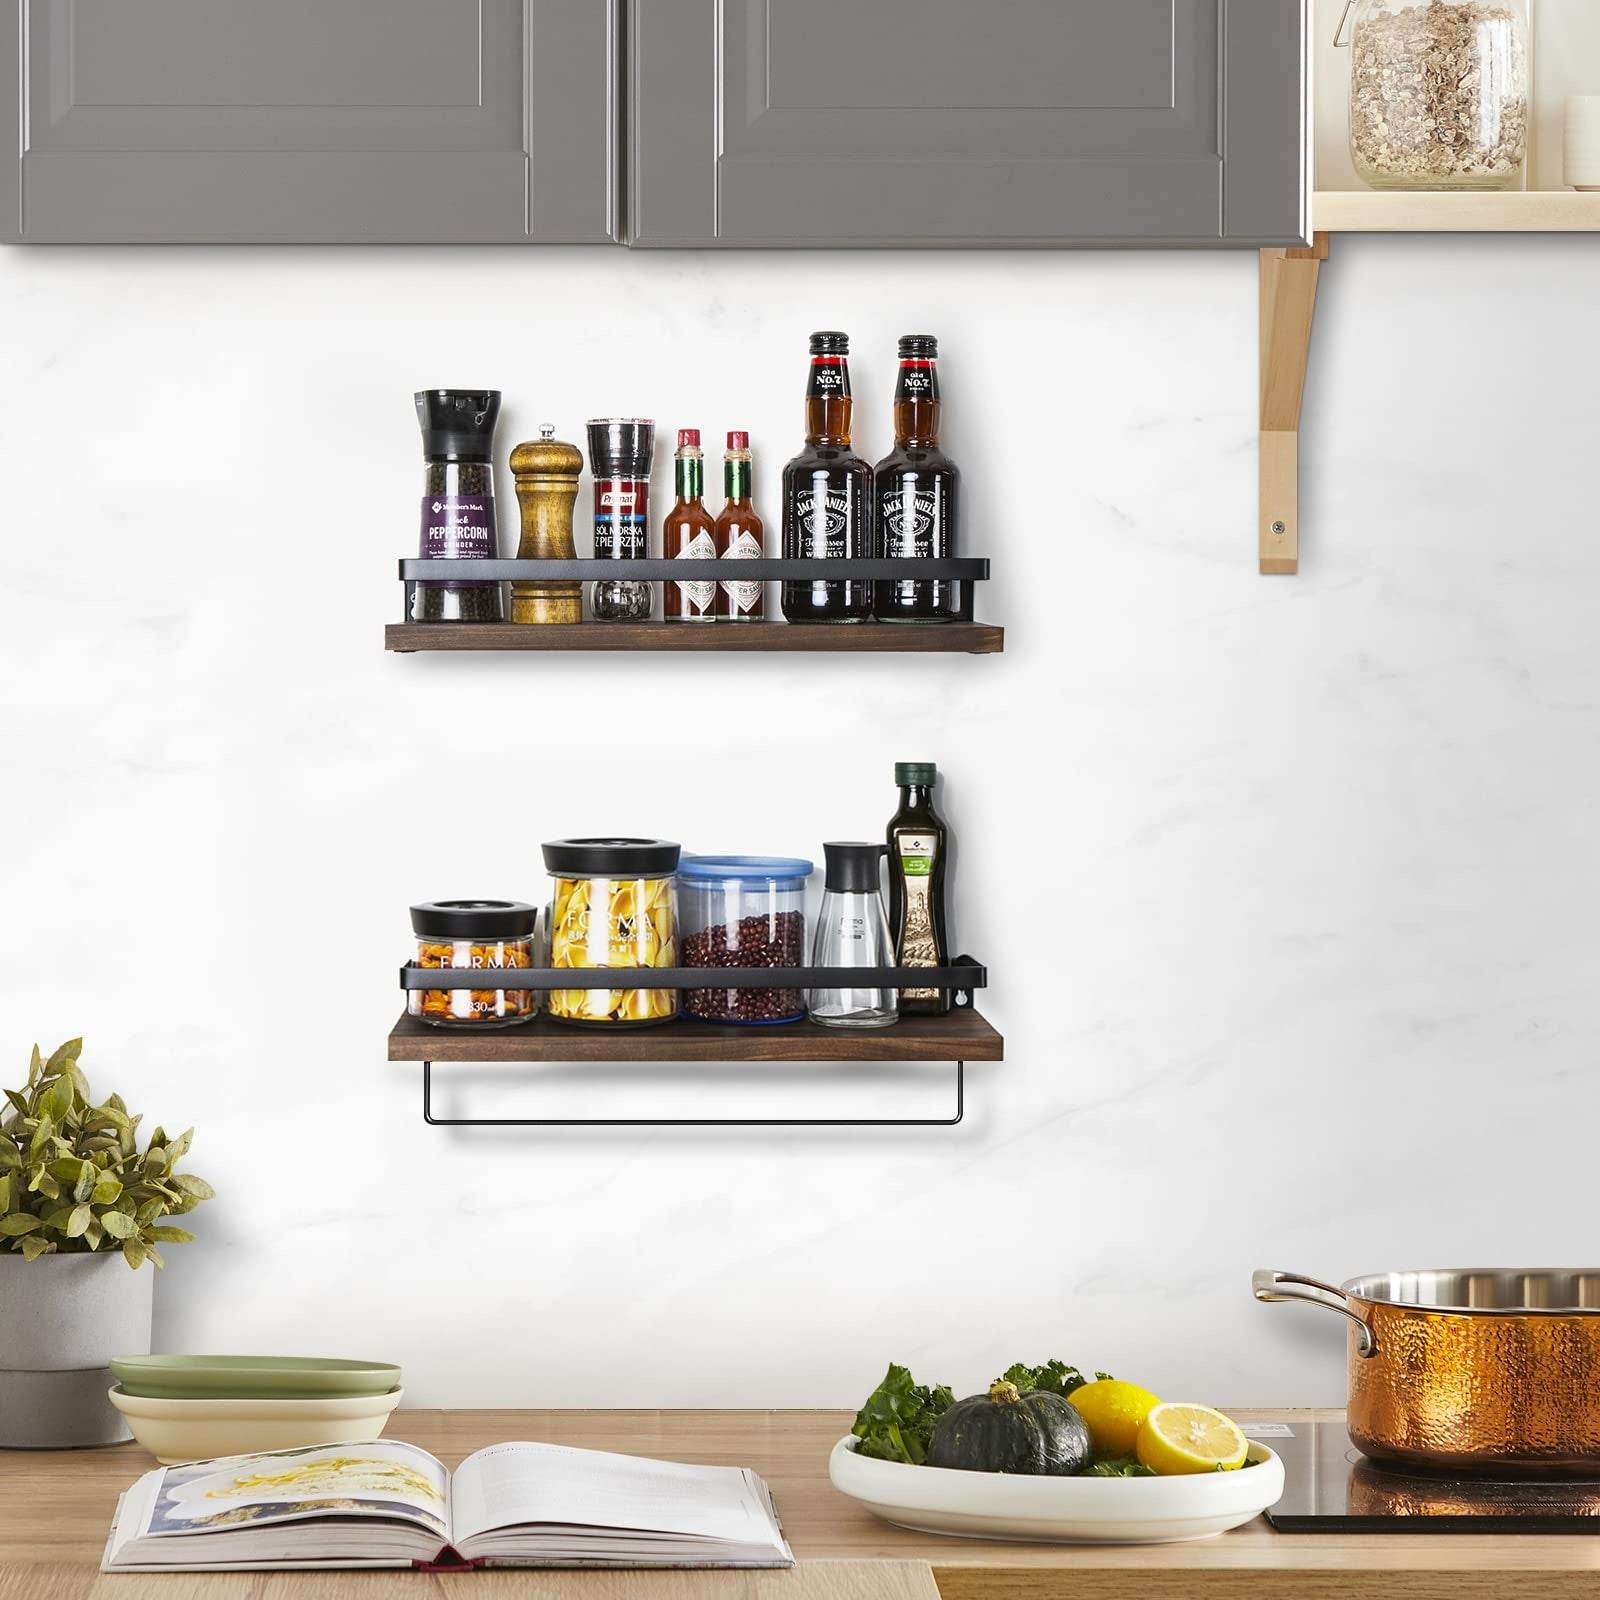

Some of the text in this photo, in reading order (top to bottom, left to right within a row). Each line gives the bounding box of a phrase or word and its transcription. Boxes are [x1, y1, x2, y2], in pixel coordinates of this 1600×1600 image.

[603, 494, 633, 504] Prmat
[797, 498, 818, 517] JACK
[882, 498, 902, 517] JACK
[599, 536, 644, 547] PIERZEM
[440, 955, 518, 969] FRMA
